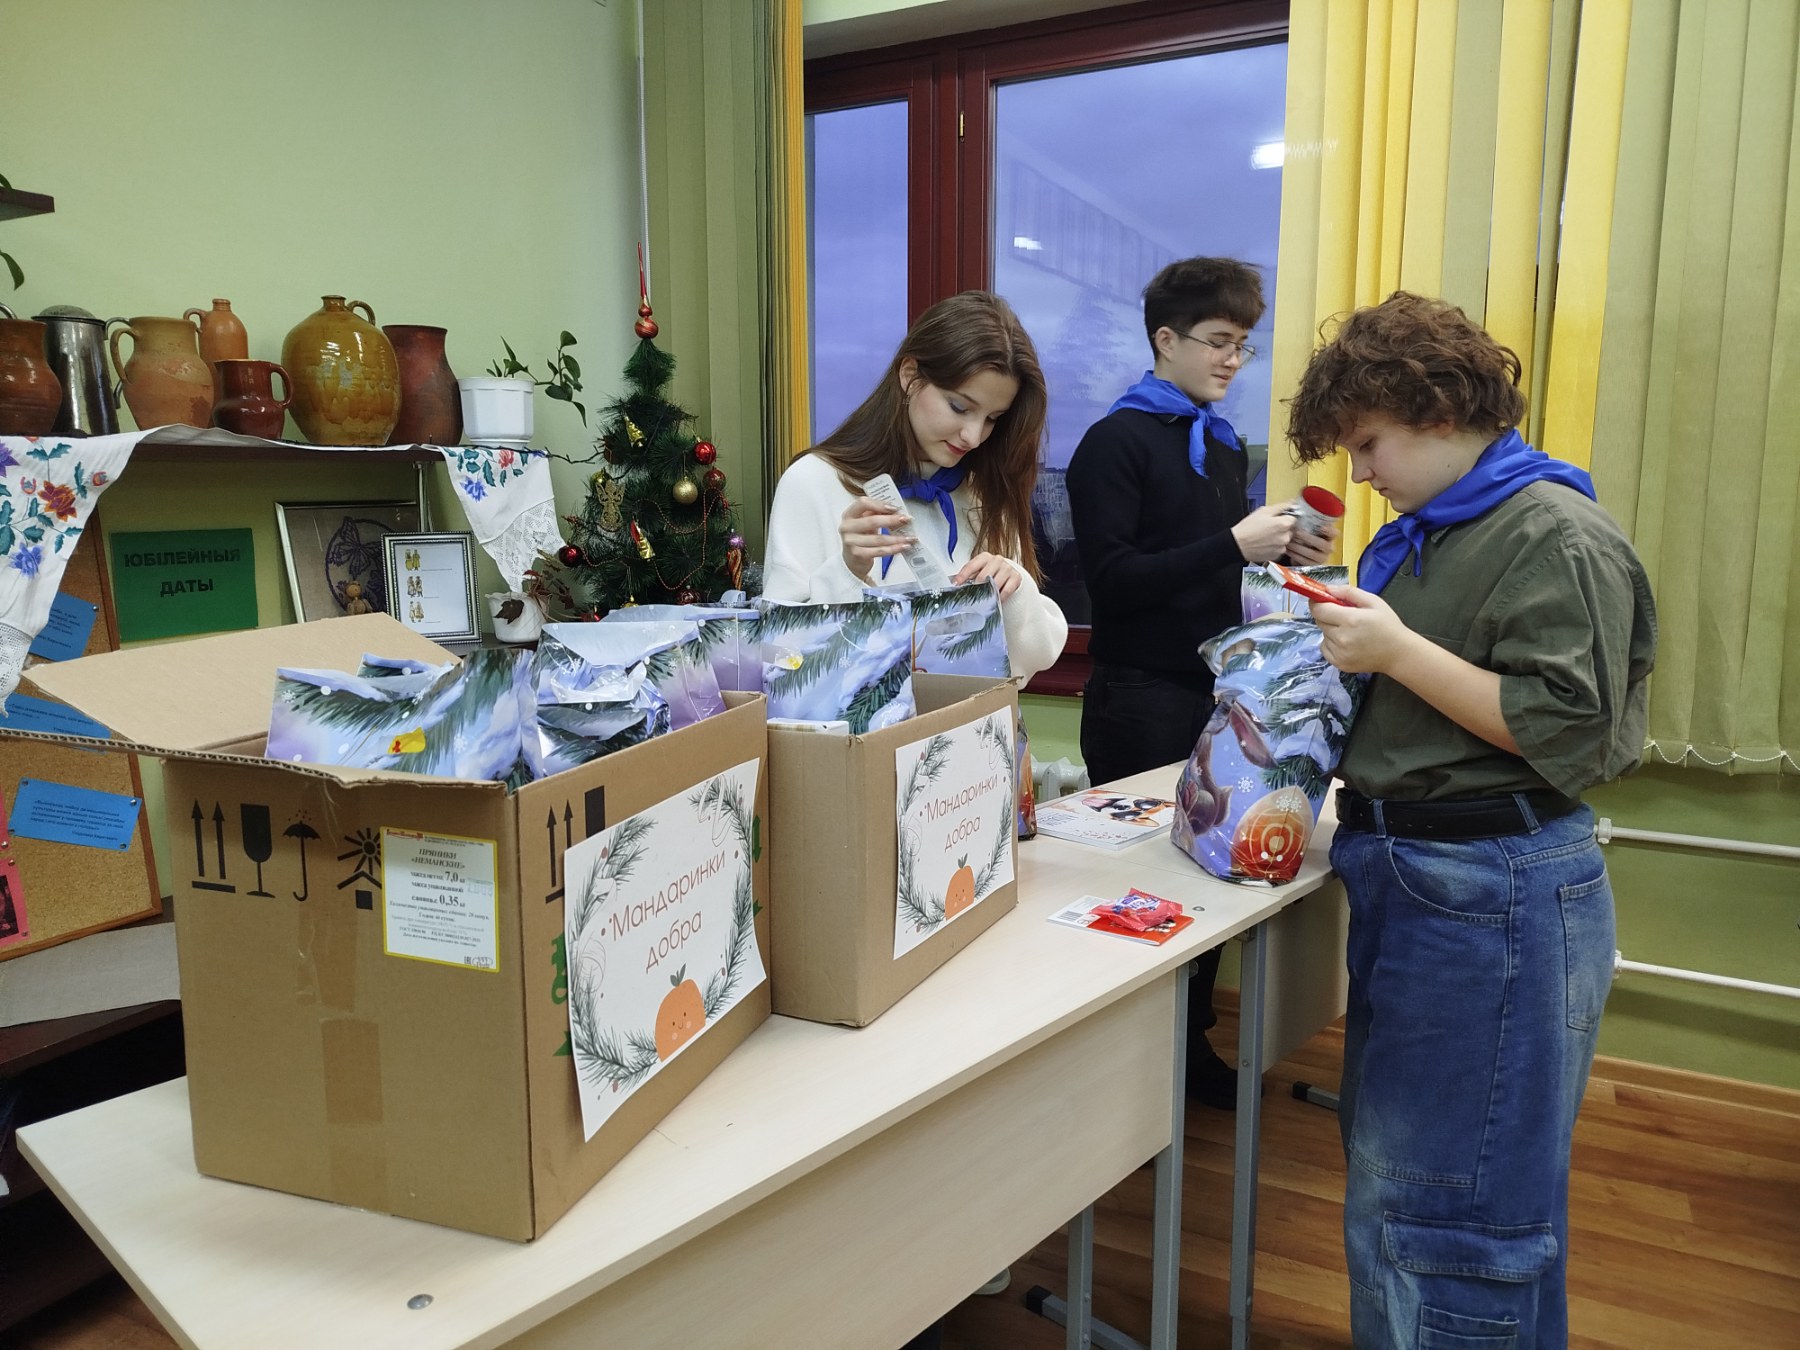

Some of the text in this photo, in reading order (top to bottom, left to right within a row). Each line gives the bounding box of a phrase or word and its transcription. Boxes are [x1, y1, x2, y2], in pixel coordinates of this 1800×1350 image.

[124, 548, 241, 568] ЮБІЛЕЙНЫЯ
[160, 578, 214, 598] ДАТЫ
[926, 773, 998, 823] Мандаринки
[944, 816, 981, 853] добра
[444, 871, 459, 883] 7,0
[439, 894, 459, 907] 0,35
[611, 850, 725, 942] Мандаринки
[645, 910, 702, 974] добра
